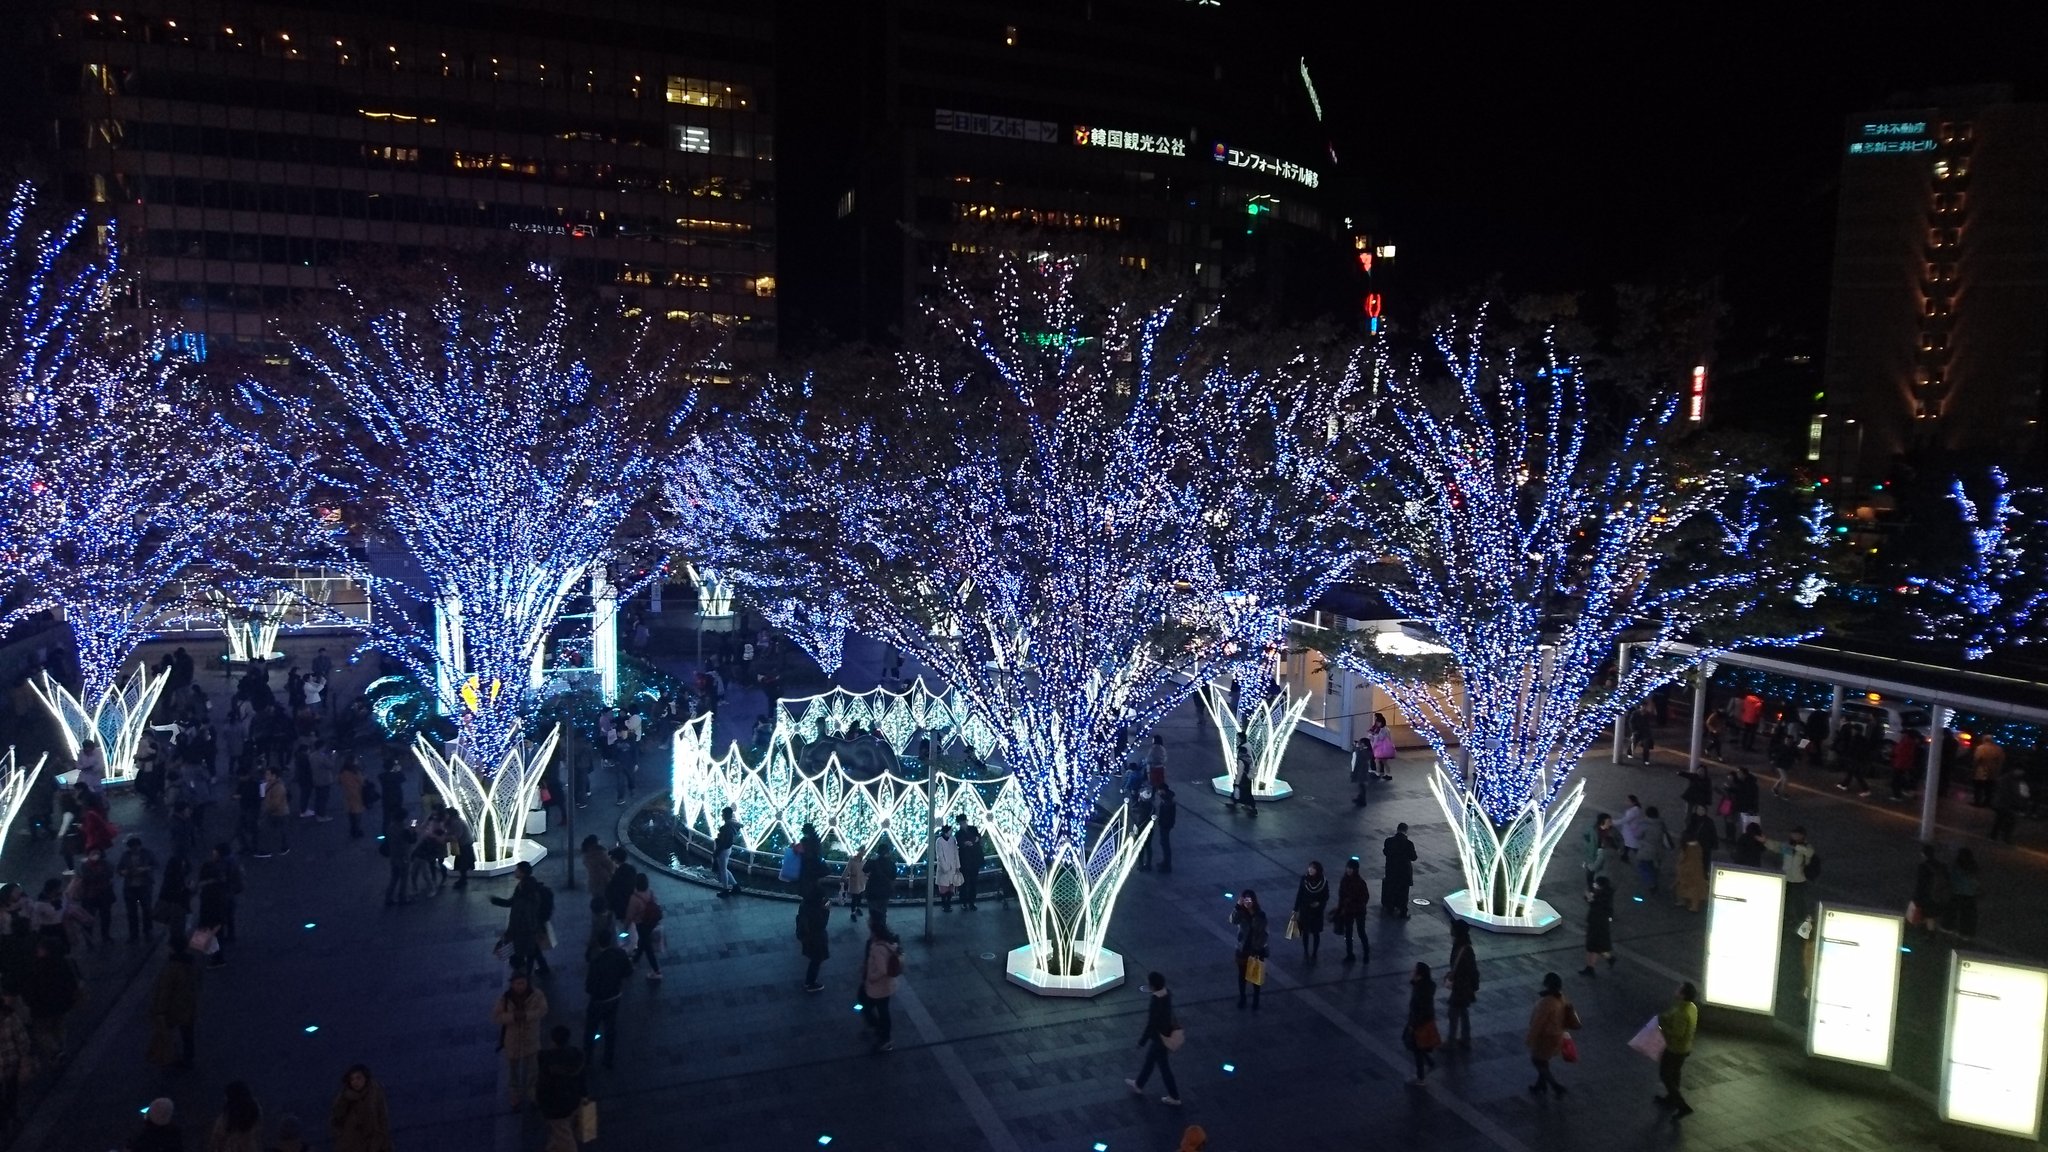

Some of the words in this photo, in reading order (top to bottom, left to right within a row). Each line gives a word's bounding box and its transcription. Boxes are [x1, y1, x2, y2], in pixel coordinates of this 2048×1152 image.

[1091, 128, 1186, 157] 韓国観光公社
[1228, 149, 1319, 189] コンフォートホテル博多
